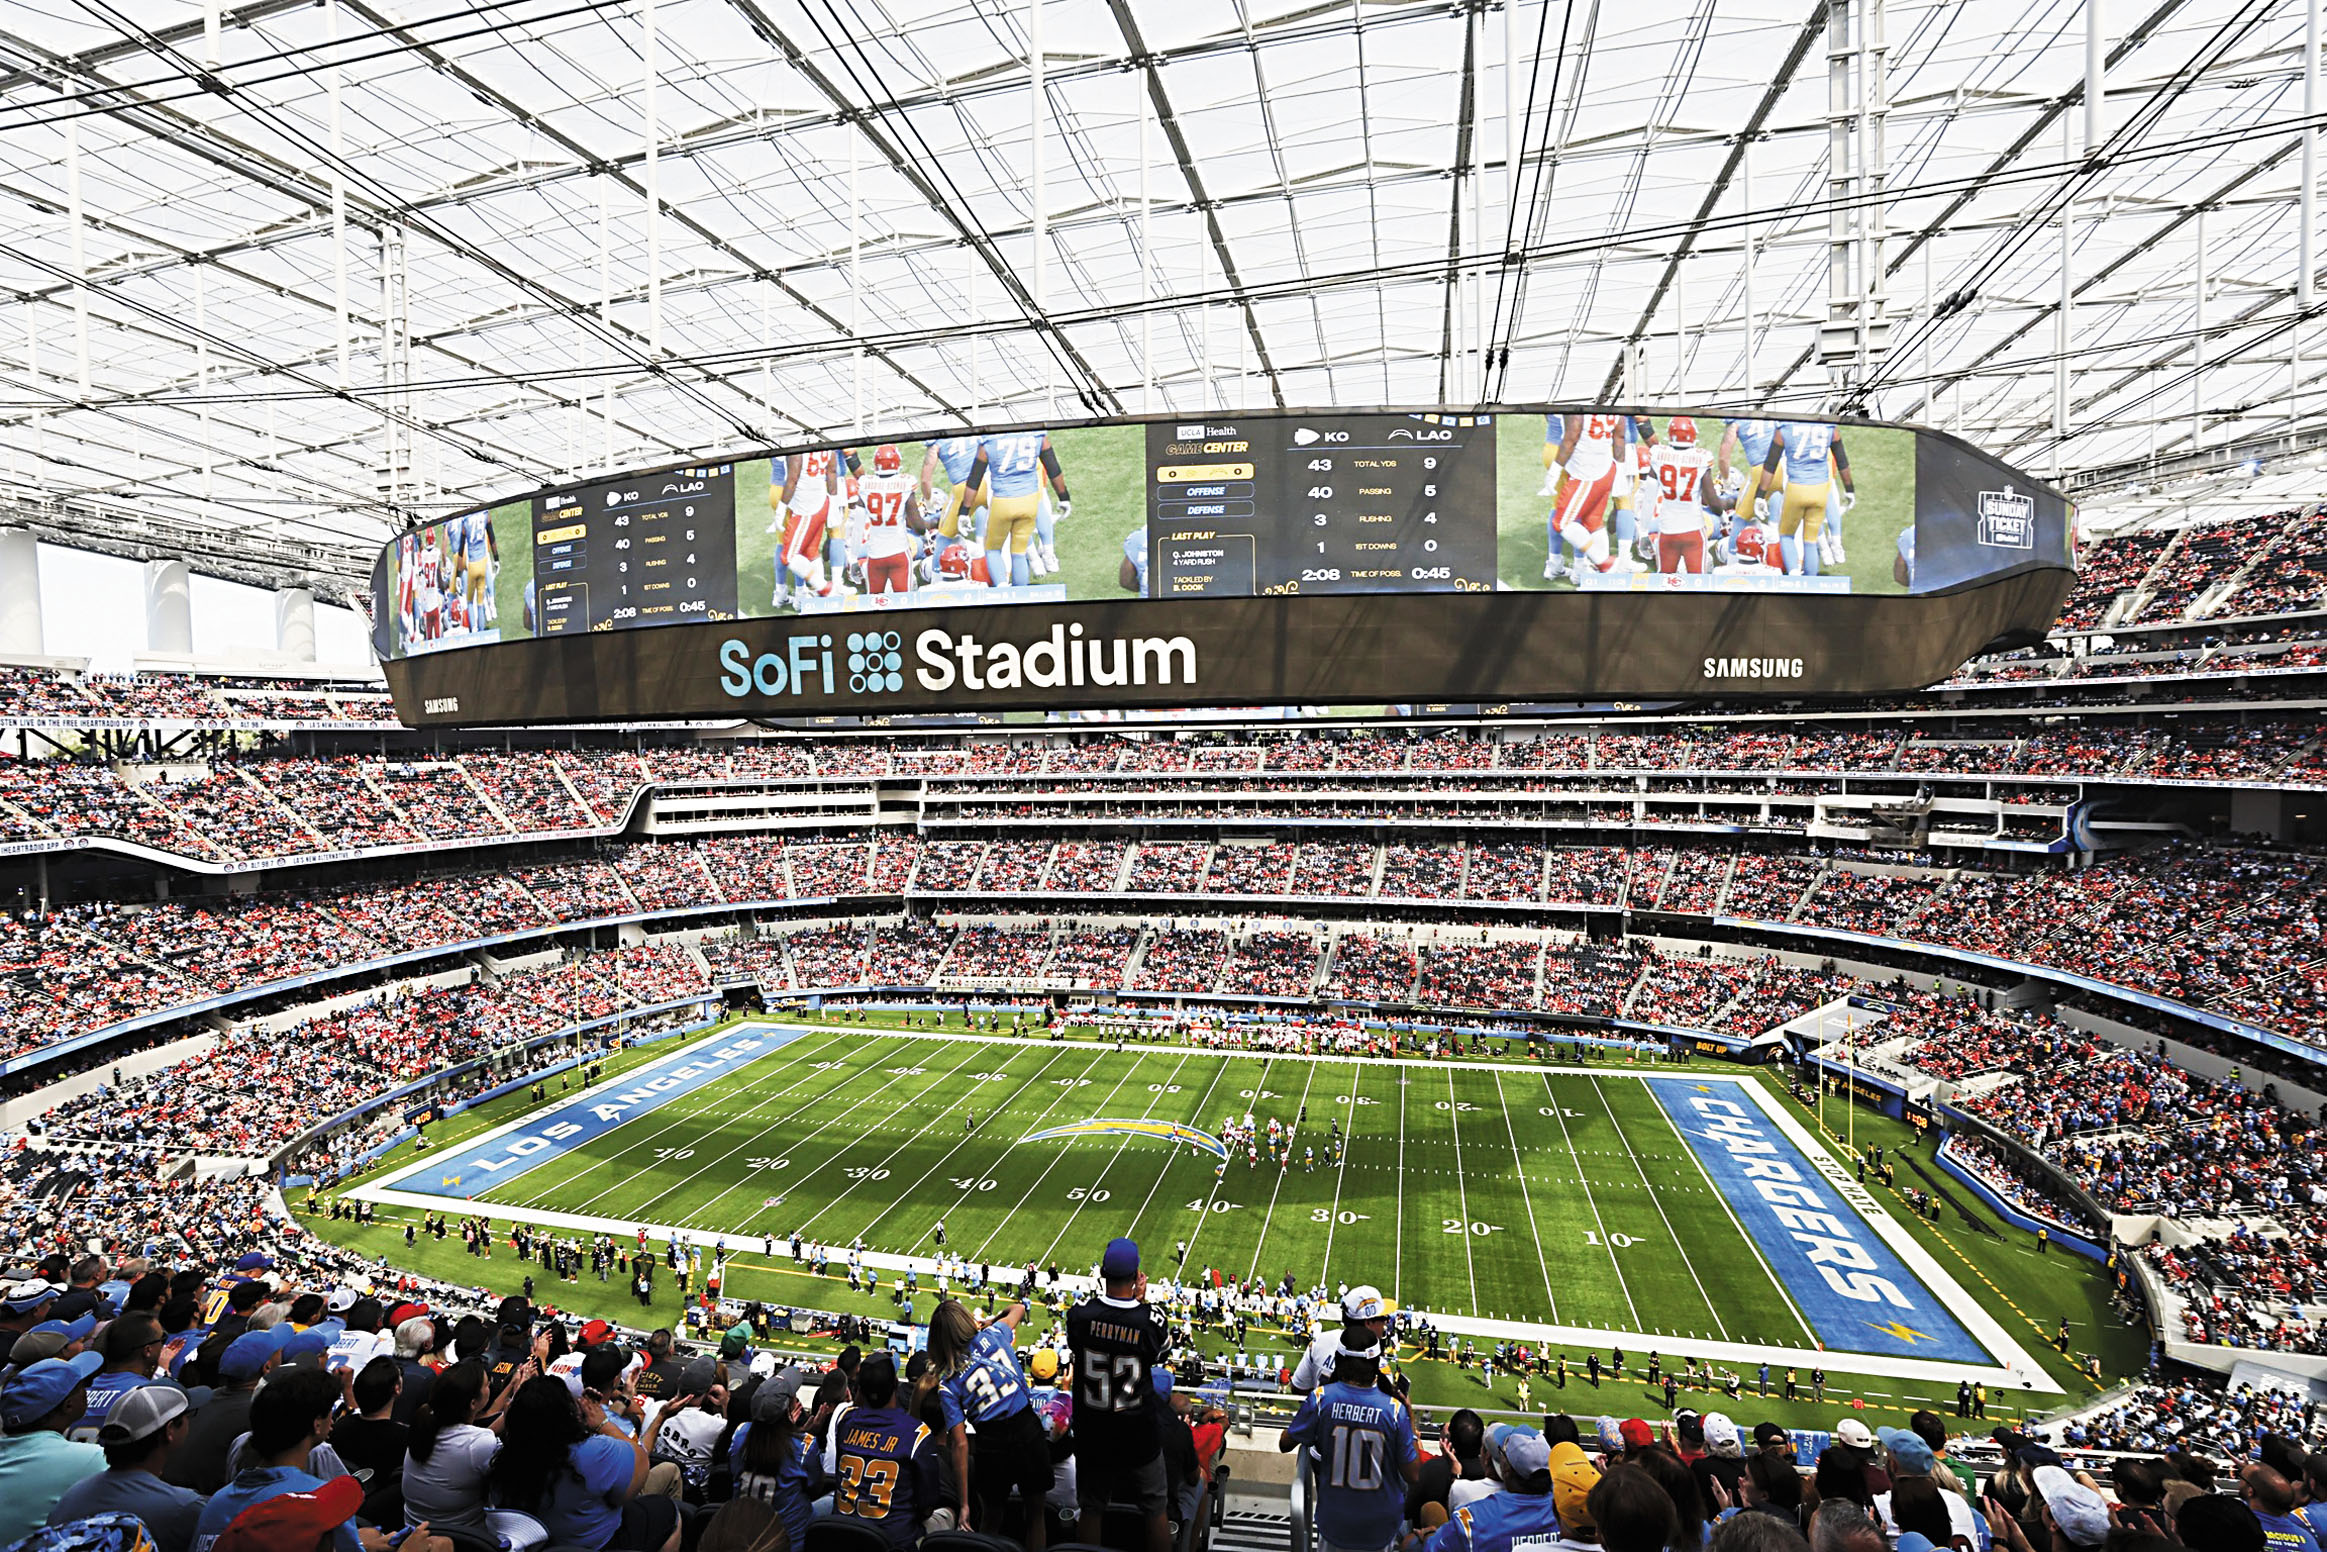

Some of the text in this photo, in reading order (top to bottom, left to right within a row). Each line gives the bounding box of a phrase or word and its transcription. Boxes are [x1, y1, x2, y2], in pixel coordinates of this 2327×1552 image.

[1206, 427, 1237, 437] Health
[1166, 441, 1249, 456] GAME CENTER
[1307, 459, 1332, 471] 43
[1354, 460, 1380, 468] TOTAL
[1423, 457, 1437, 469] 9
[1660, 464, 1697, 501] 97
[1187, 486, 1225, 496] OFFENSE
[1307, 486, 1333, 499] 40
[1424, 484, 1437, 497] 5
[685, 506, 694, 516] 9
[867, 493, 903, 527] 97
[1187, 505, 1225, 515] DEFENSE
[1986, 501, 2029, 517] SUNDAY
[615, 516, 629, 527] 43
[1314, 513, 1327, 526] 3
[1359, 515, 1392, 523] RUSHING
[1424, 512, 1437, 524] 4
[1988, 516, 2026, 534] TICKET
[686, 530, 695, 541] 5
[1172, 531, 1216, 541] LAST PLAY
[615, 539, 630, 550] 40
[1317, 541, 1325, 553] 1
[1424, 539, 1438, 552] 0
[686, 554, 696, 564] 4
[1181, 550, 1224, 558] JOHNSTON
[619, 562, 628, 572] 3
[1411, 567, 1451, 579] 0:45
[424, 562, 435, 588] 97
[1301, 569, 1341, 581] 2:08
[621, 585, 627, 595] 1
[687, 578, 696, 588] 0
[613, 607, 637, 619] 2:08
[679, 601, 706, 613] 0:45
[719, 622, 1197, 697] SoFi Stadium
[1704, 658, 1803, 678] SAMSUNG
[425, 697, 458, 714] SAMSUNG
[1696, 1041, 1727, 1054] BOLT UP
[468, 1038, 764, 1172] LOS ANGELES
[667, 1147, 696, 1162] 10
[757, 1156, 791, 1171] 20
[854, 1166, 890, 1182] 30
[957, 1177, 998, 1192] 40
[1813, 1156, 1883, 1215] STOP HATE
[1066, 1187, 1112, 1203] 50
[1185, 1199, 1233, 1214] 40
[1685, 1096, 1916, 1310] CHARGERS
[1310, 1209, 1358, 1225] 30
[1443, 1219, 1492, 1237] 20
[1583, 1231, 1634, 1249] 10
[1090, 1320, 1141, 1344] PERRYMAN
[979, 1336, 991, 1353] JR
[1083, 1350, 1143, 1412] 52
[1331, 1401, 1383, 1425] HERBERT
[844, 1429, 899, 1453] JAMES JR
[1330, 1426, 1386, 1490] 10
[837, 1454, 900, 1519] 33
